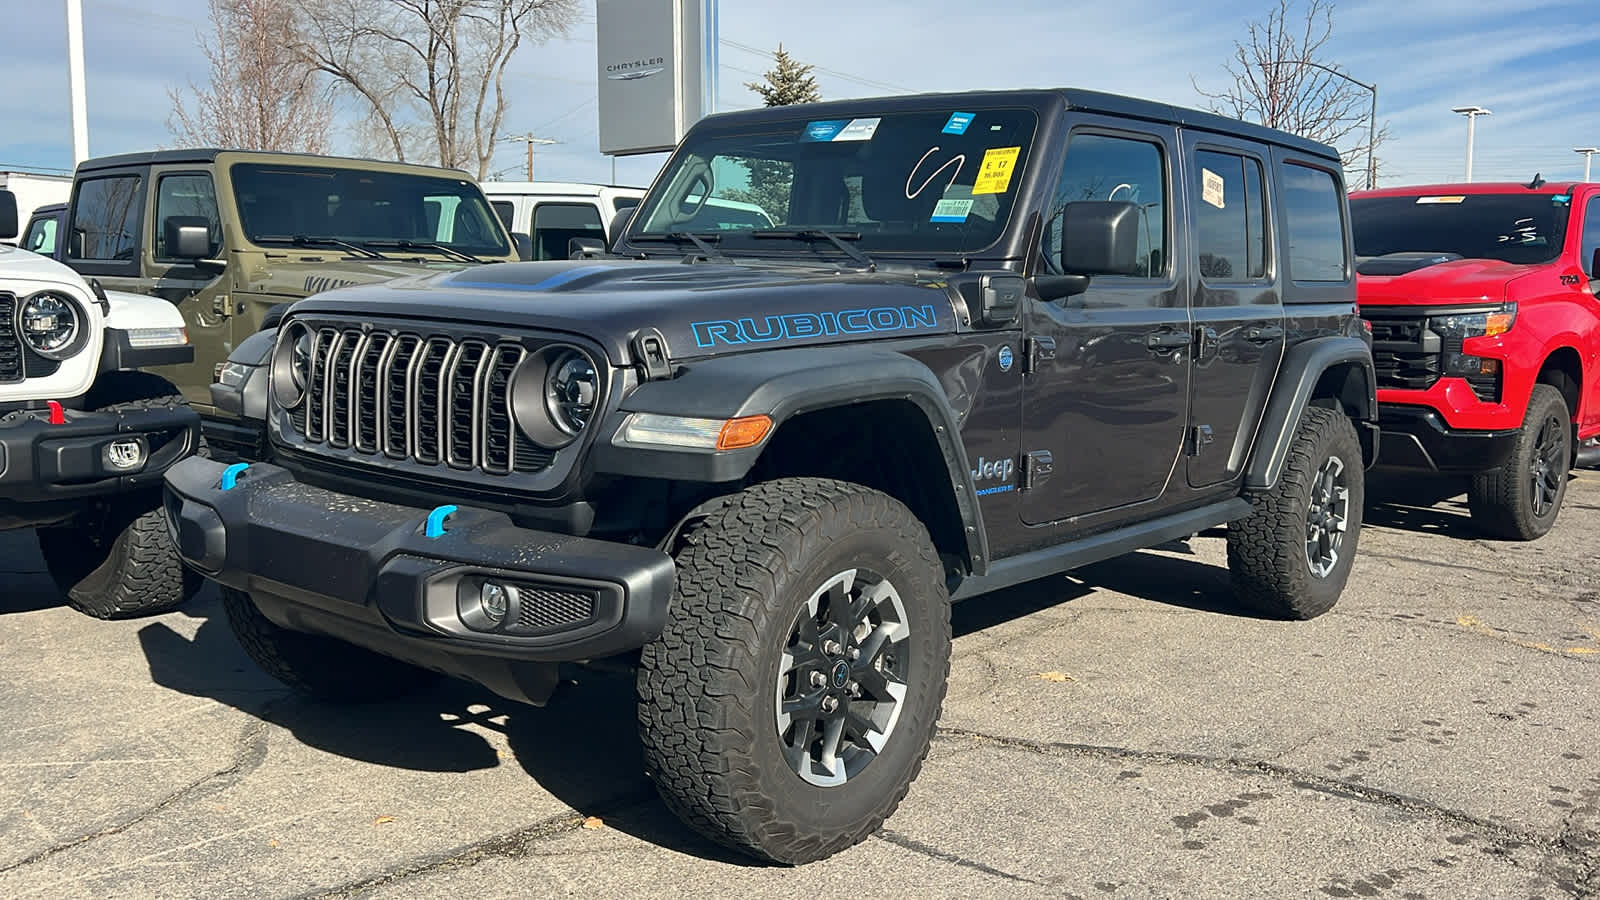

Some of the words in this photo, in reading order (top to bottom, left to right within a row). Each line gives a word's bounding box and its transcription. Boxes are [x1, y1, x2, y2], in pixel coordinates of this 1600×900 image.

[606, 56, 664, 72] CHRYSLER
[691, 304, 938, 348] RUBICON
[969, 456, 1014, 481] Jeep
